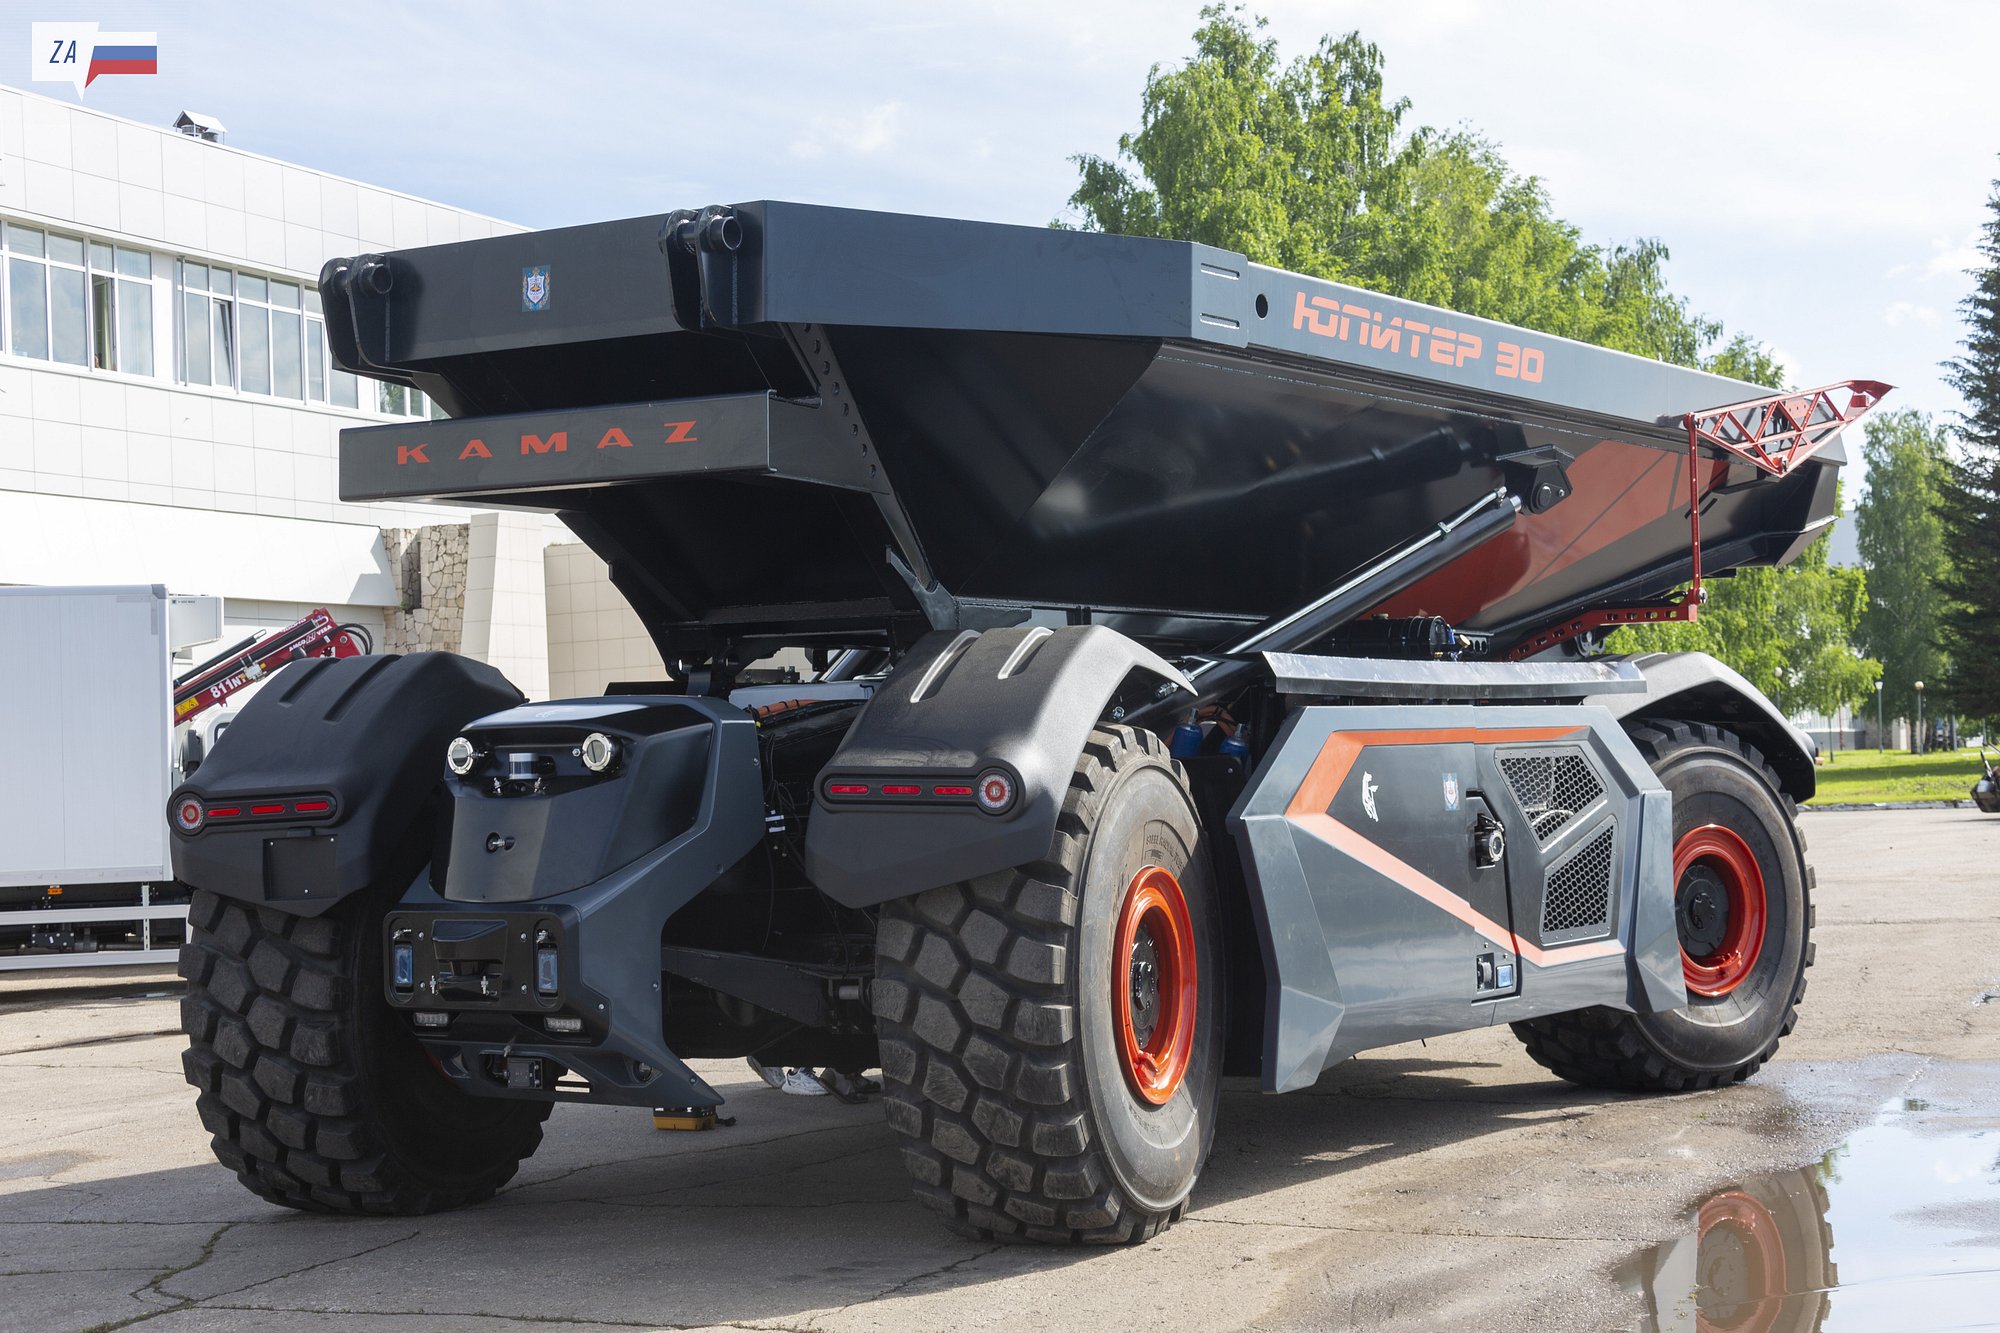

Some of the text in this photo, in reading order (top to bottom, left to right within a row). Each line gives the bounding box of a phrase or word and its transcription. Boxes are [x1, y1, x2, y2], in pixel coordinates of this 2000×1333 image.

[1293, 291, 1545, 384] ЮПИТЕР 30
[397, 420, 699, 465] KAMAZ
